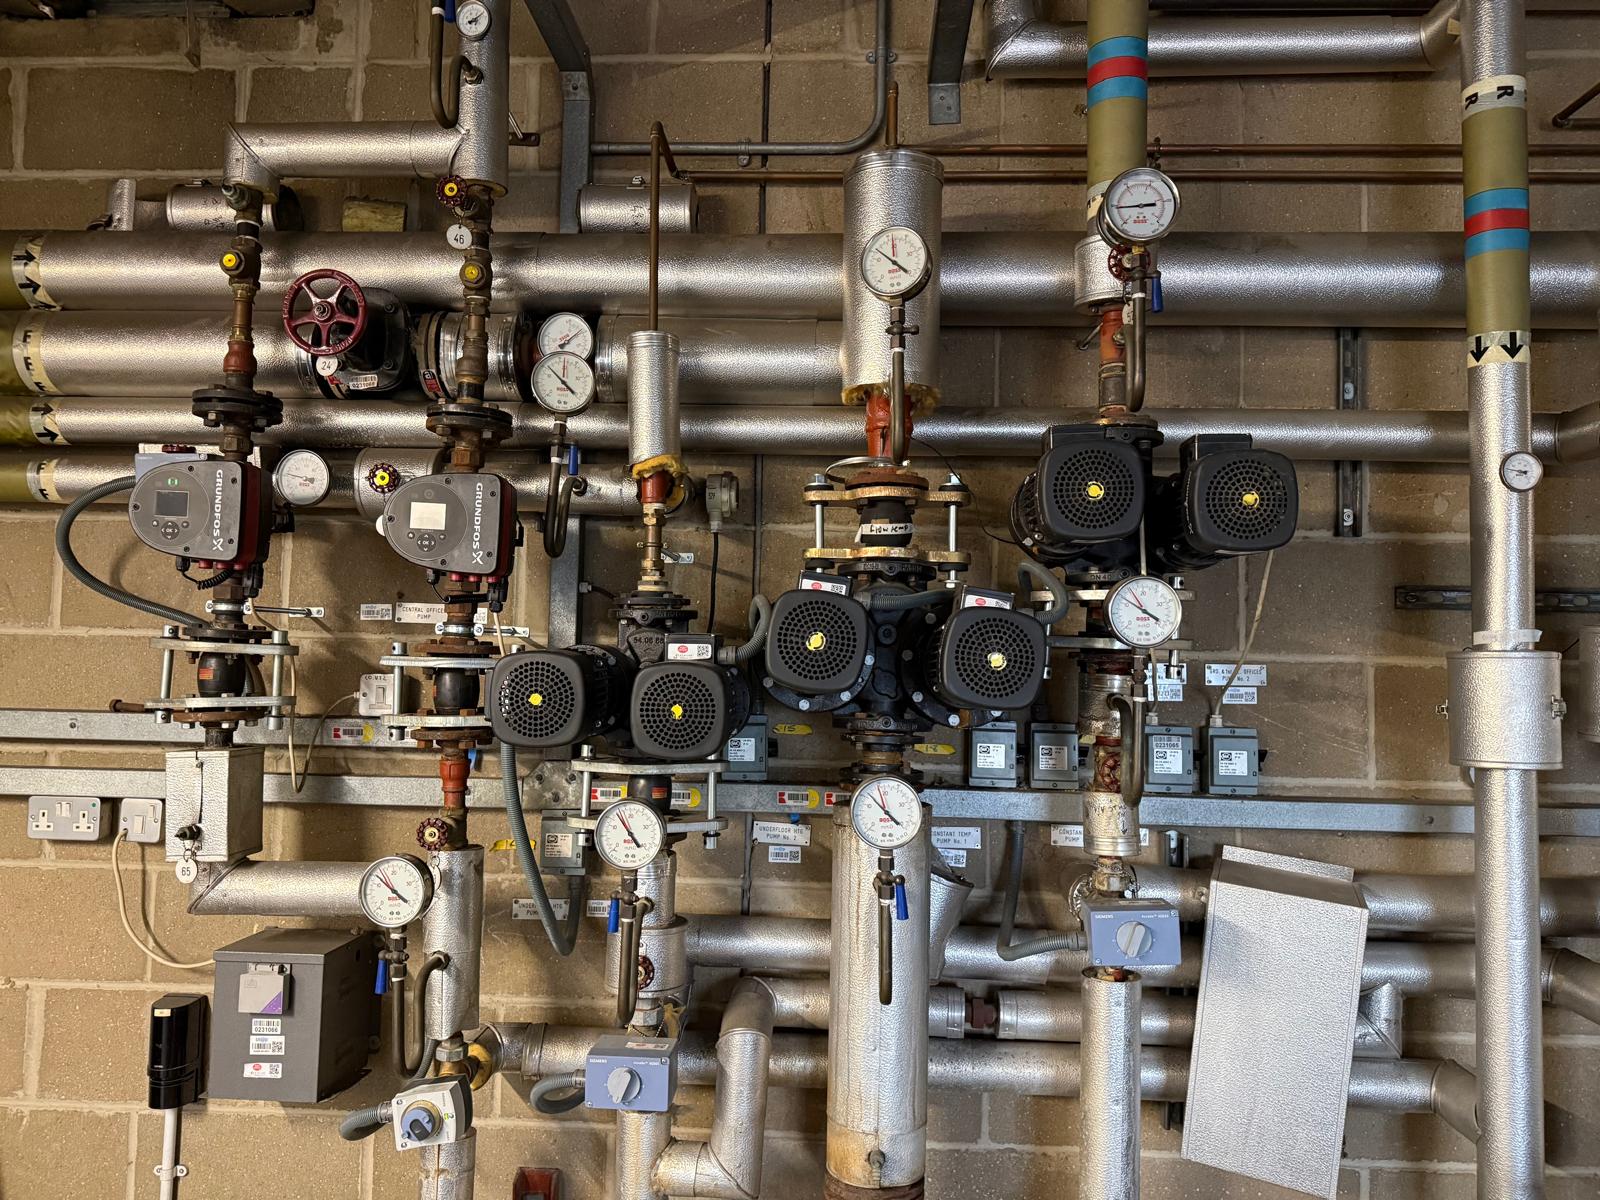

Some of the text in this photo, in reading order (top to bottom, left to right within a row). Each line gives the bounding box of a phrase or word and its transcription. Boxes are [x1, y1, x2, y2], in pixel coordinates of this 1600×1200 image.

[1497, 85, 1514, 100] R
[1465, 92, 1478, 110] R
[453, 233, 465, 244] 46
[23, 330, 33, 343] F
[321, 361, 332, 371] 24
[213, 469, 223, 537] GRUNDFOS
[472, 482, 484, 550] GRUNDFOS
[181, 866, 191, 877] 65
